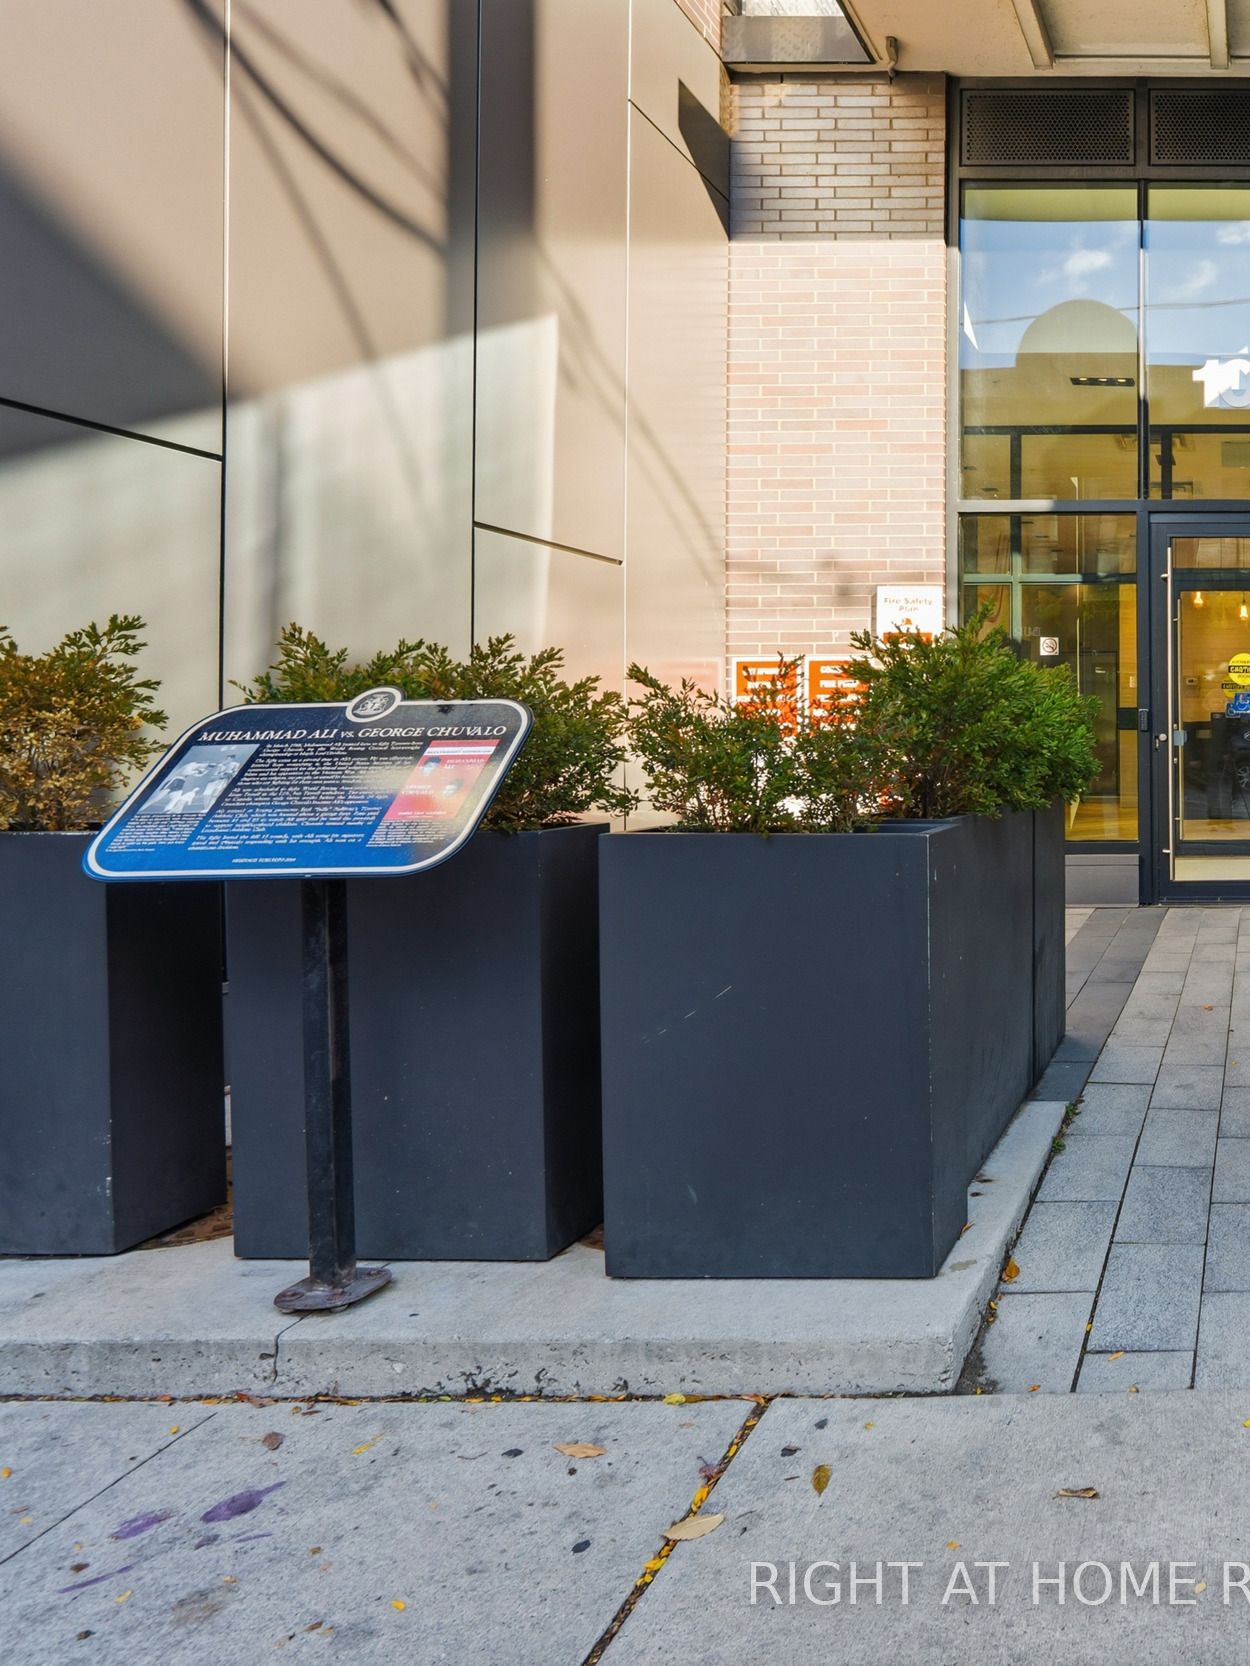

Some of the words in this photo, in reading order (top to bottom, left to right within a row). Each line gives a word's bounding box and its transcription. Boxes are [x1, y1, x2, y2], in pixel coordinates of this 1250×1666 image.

[904, 597, 932, 606] Safety
[198, 730, 307, 741] MUHAMMAD
[307, 729, 339, 739] ALI
[358, 727, 425, 737] GEORGE
[427, 726, 507, 736] CHUVALO
